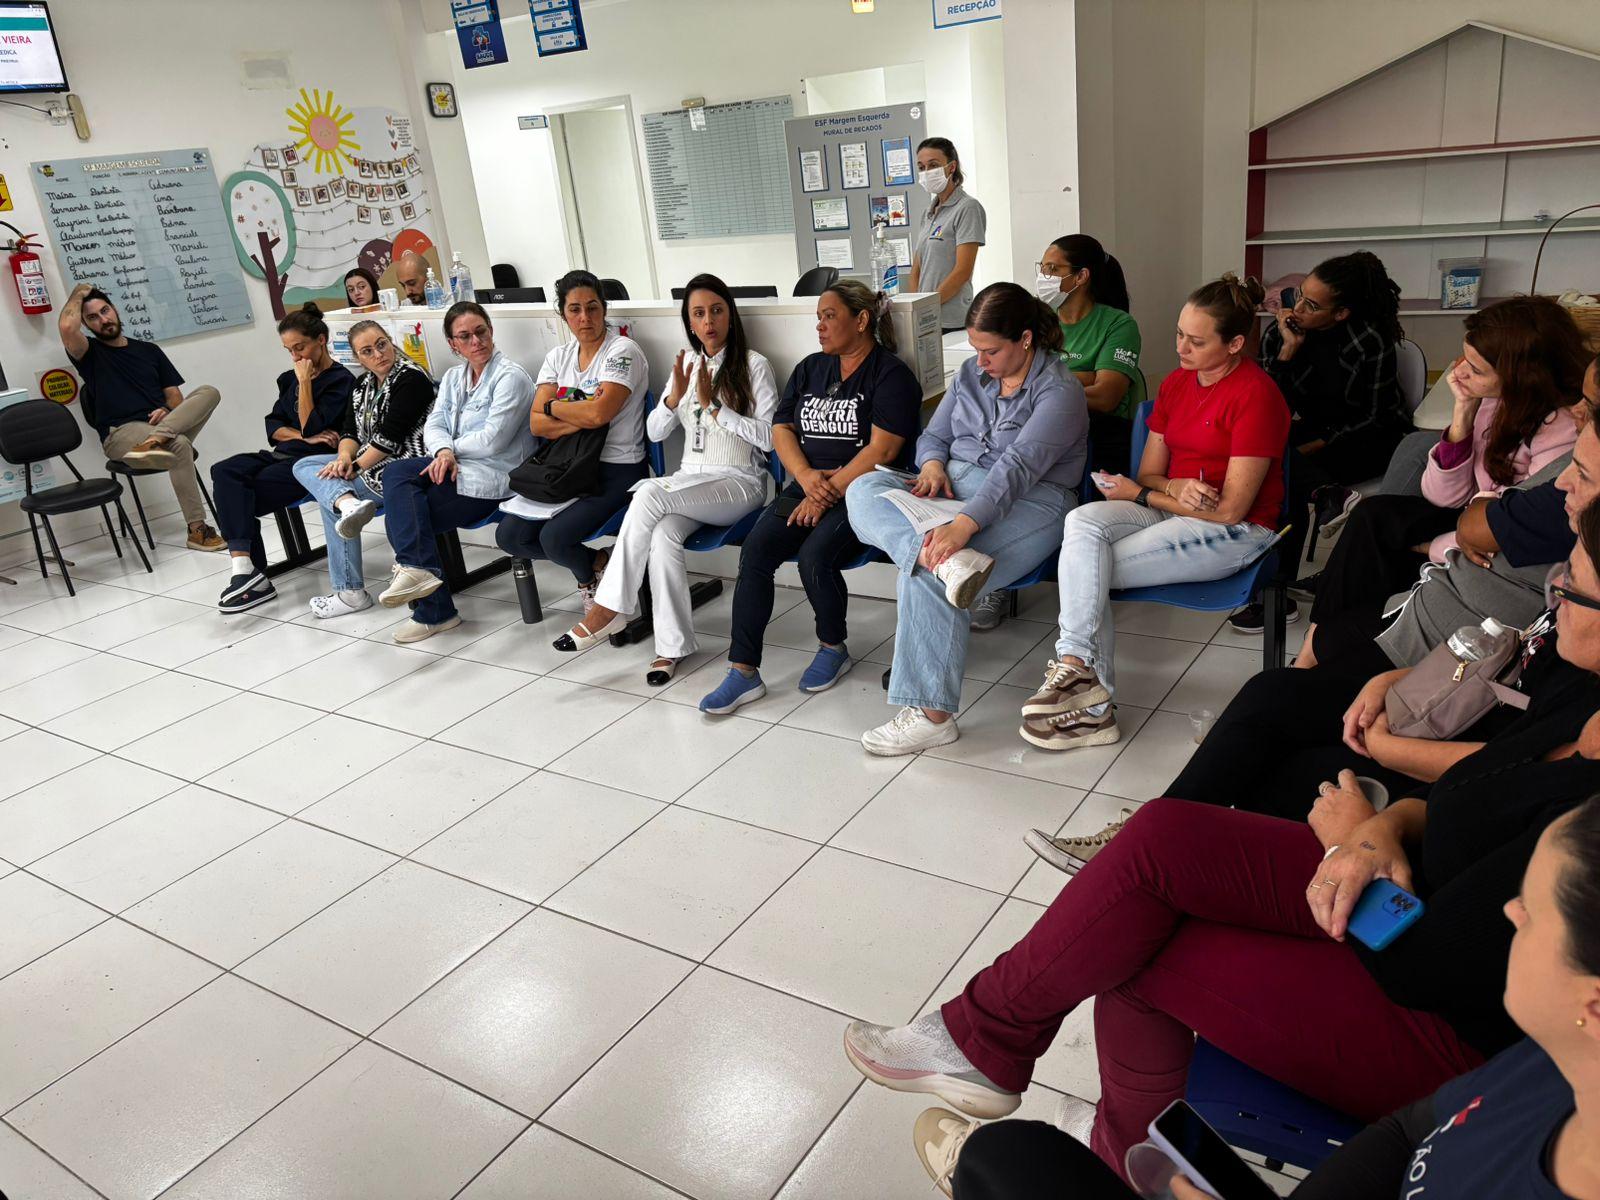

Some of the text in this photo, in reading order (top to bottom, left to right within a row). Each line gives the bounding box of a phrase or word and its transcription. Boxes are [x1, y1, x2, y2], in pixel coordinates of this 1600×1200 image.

[2, 35, 32, 44] VIEIRA
[814, 111, 890, 127] ESF Margem Esquerda
[854, 124, 882, 133] RECADOS
[804, 397, 858, 409] JUNTOS
[800, 407, 857, 421] CONTRA
[800, 420, 859, 435] DENGUE
